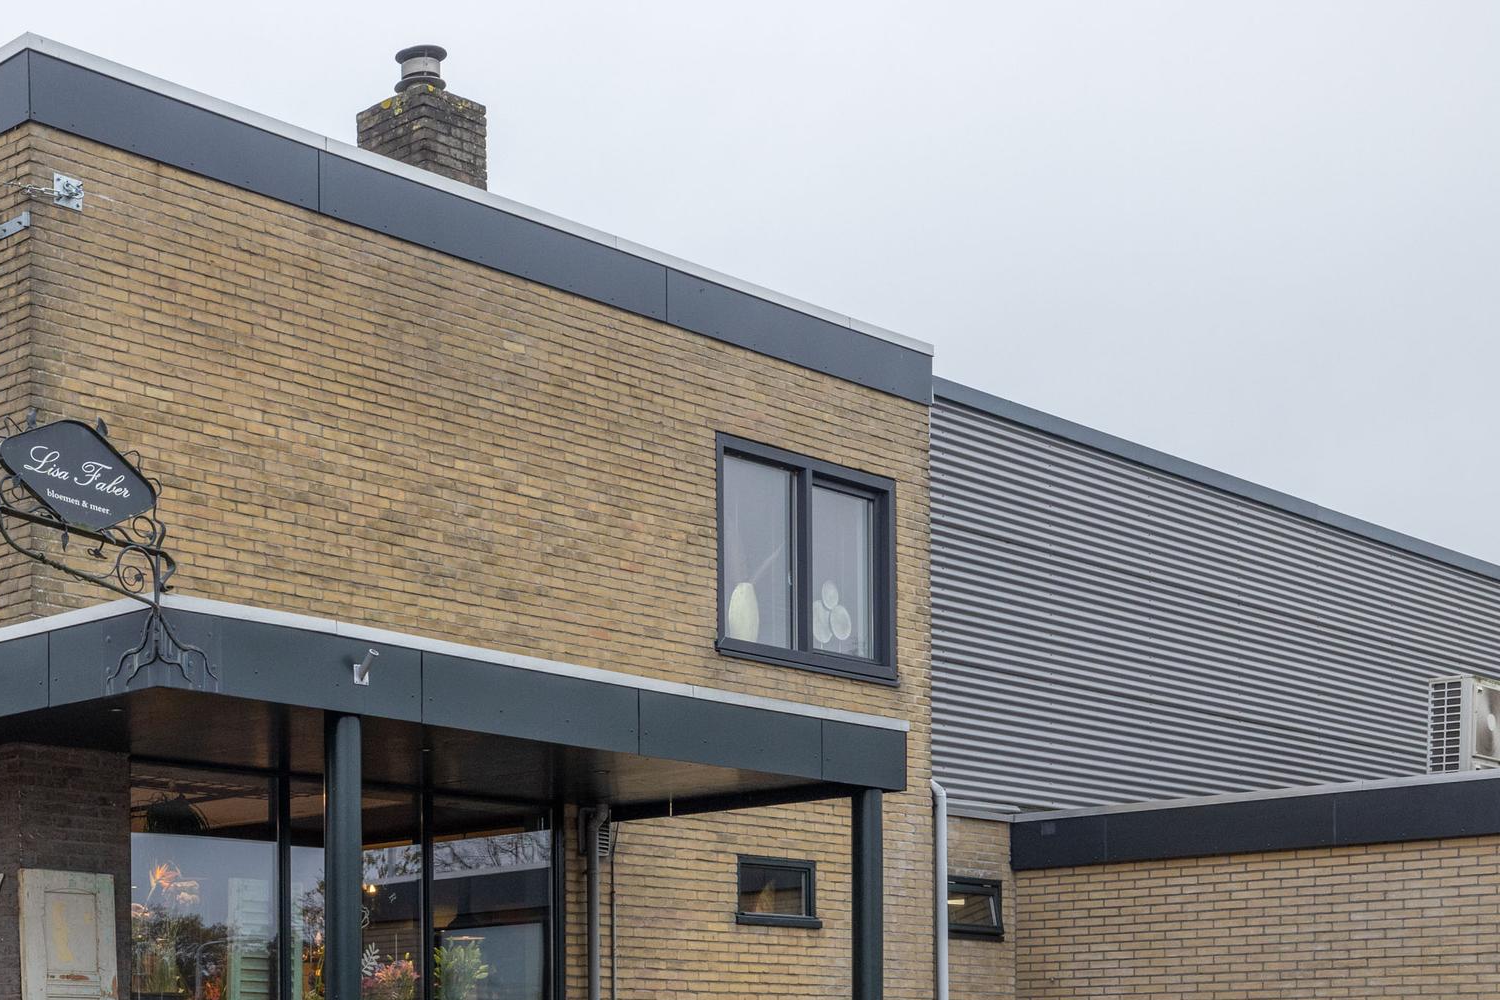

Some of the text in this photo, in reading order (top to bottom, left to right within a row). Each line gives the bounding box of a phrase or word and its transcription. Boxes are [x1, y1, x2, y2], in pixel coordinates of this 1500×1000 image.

[23, 445, 131, 499] Lisa Faber
[46, 488, 80, 507] bloemen
[81, 500, 89, 509] &
